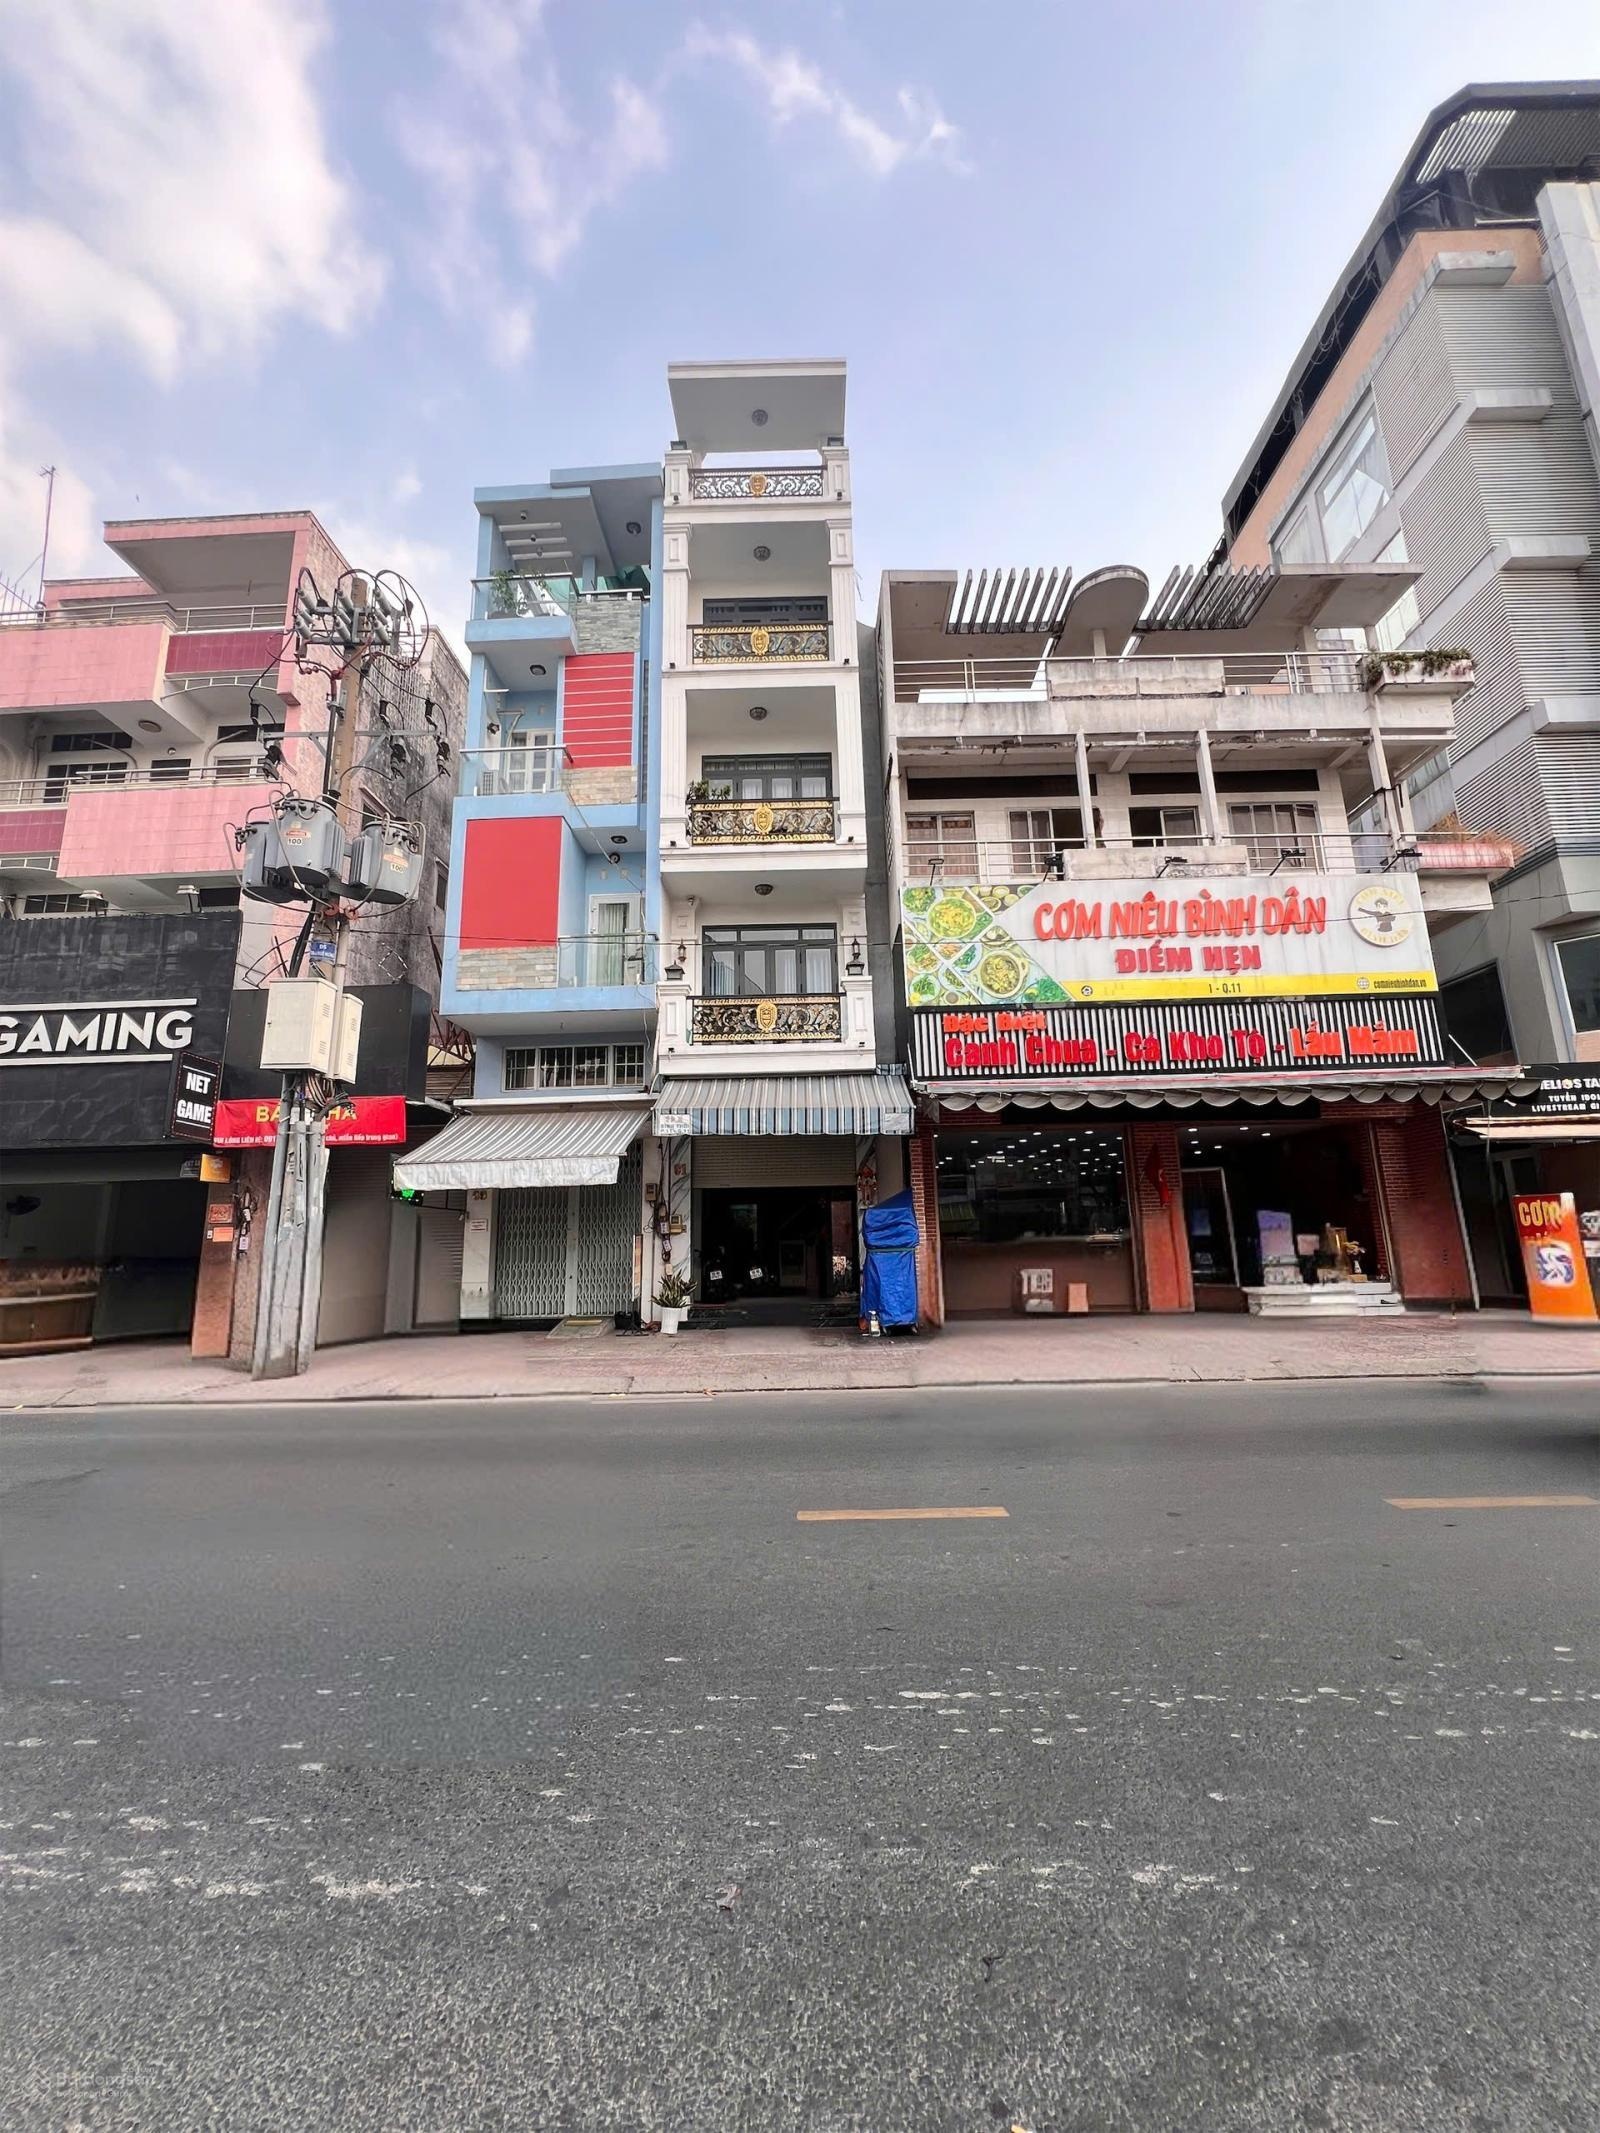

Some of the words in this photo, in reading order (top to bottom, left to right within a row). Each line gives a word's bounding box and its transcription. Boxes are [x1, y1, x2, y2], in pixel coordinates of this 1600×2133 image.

[1033, 899, 1102, 941] CƠM
[1109, 890, 1178, 939] NIÊU
[1184, 888, 1257, 938] BÌNH
[1262, 886, 1326, 935] DÂN
[1203, 944, 1262, 975] HẸN
[1222, 982, 1242, 994] Q.11
[945, 1036, 1017, 1068] Canh
[1025, 1034, 1098, 1066] Chua
[1169, 1029, 1224, 1061] Kho
[186, 1072, 211, 1095] NET
[177, 1099, 212, 1124] GAME
[1532, 1103, 1586, 1112] LIVESTREAM
